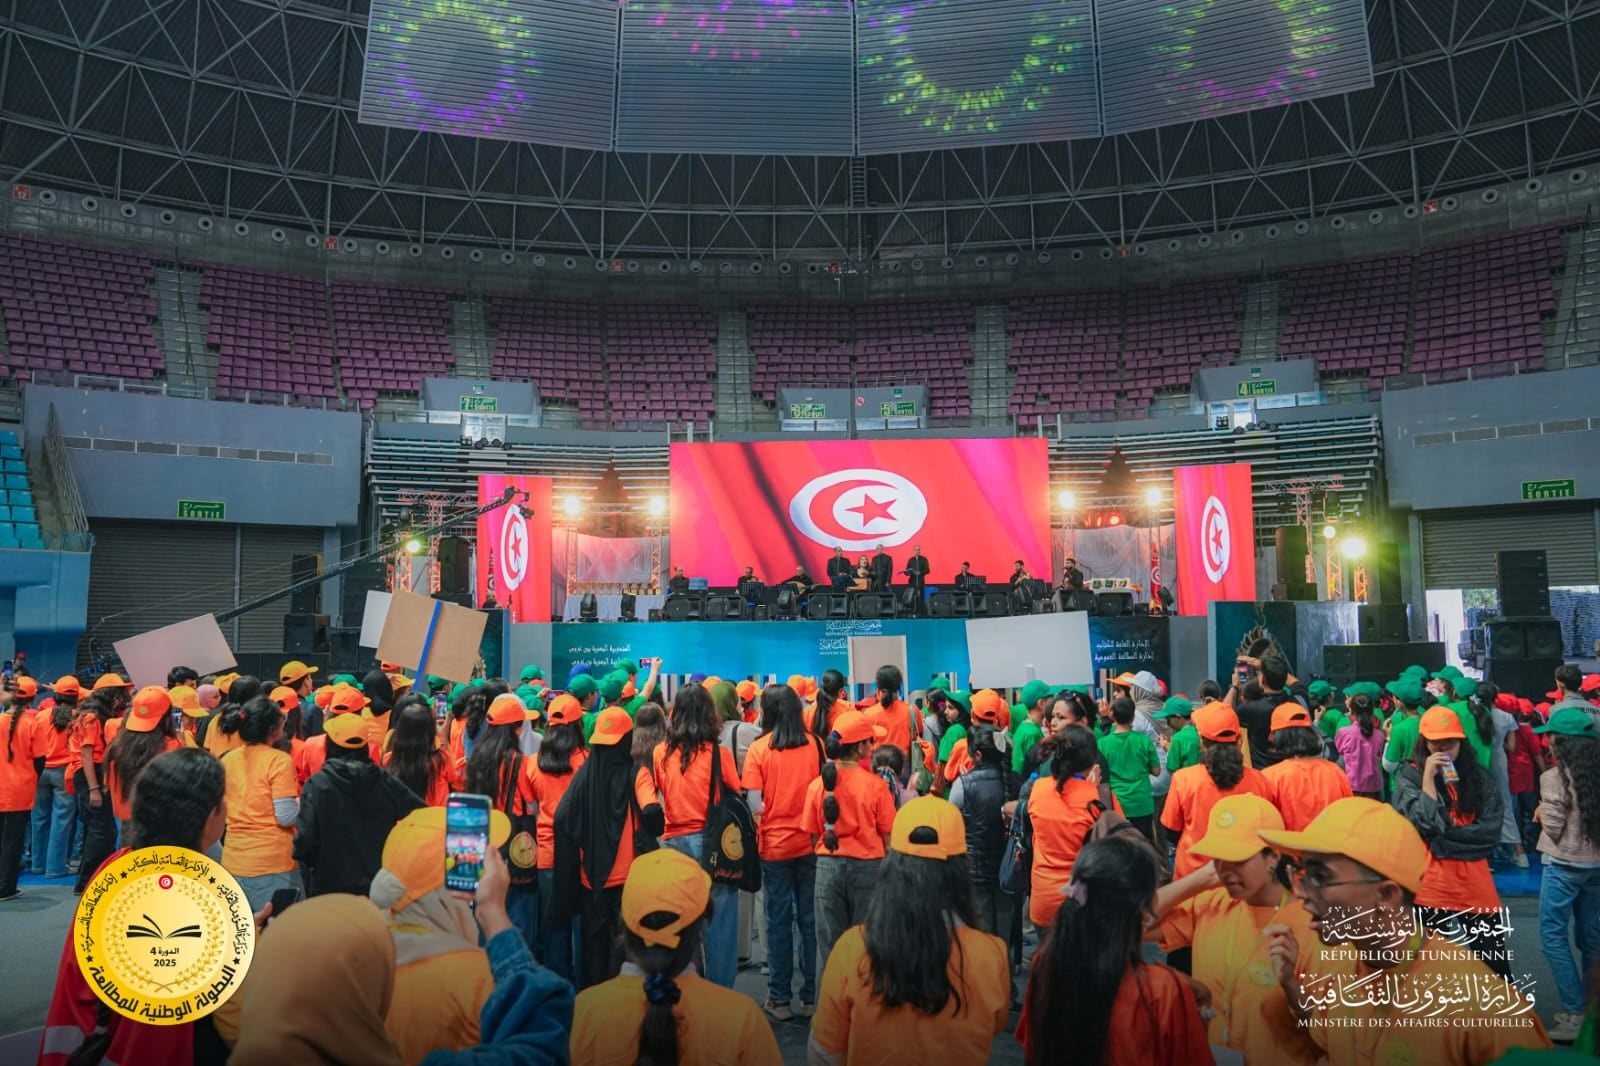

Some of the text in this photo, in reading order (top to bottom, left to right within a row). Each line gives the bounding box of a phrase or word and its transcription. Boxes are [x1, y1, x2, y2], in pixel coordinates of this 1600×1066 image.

[1240, 383, 1248, 396] 4
[463, 397, 471, 410] 7
[1527, 480, 1569, 491] خروج
[1527, 489, 1570, 499] SORTIE
[184, 509, 220, 519] SORTIE
